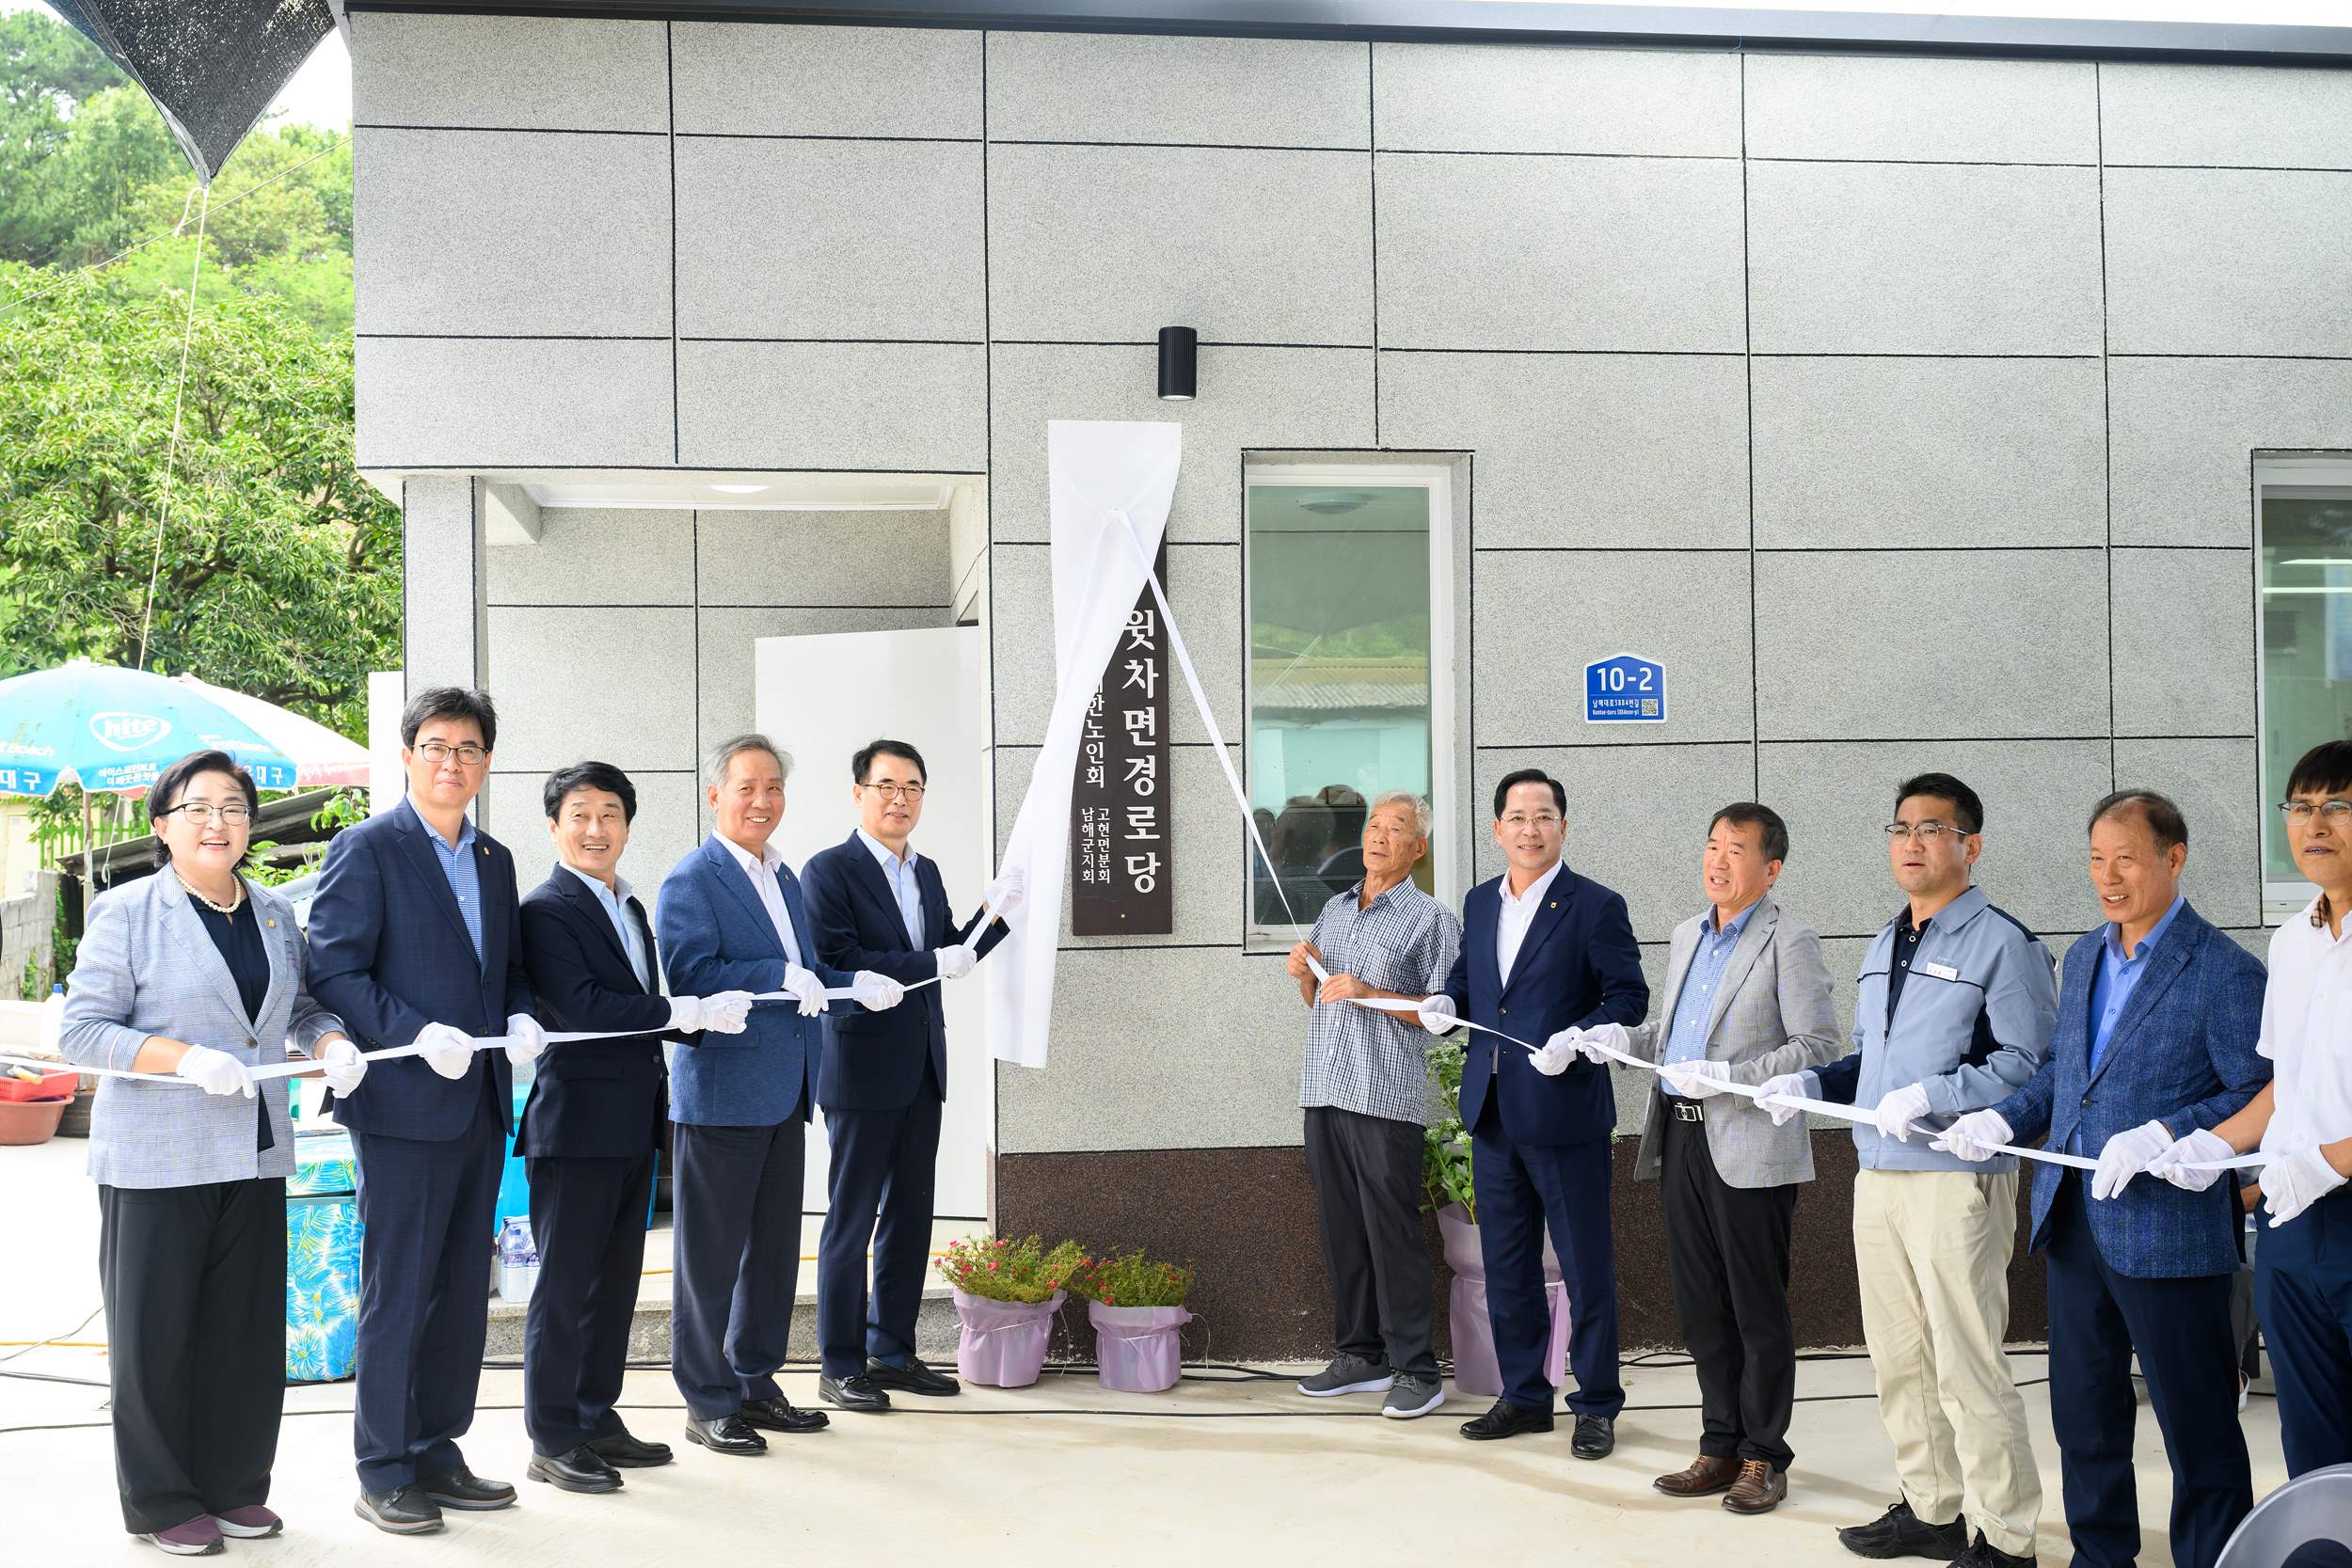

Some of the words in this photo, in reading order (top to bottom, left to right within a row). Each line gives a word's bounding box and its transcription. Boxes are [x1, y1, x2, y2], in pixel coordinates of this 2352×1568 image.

[1597, 667, 1653, 691] 10-2
[104, 718, 158, 738] hite
[1085, 677, 1105, 788] 한노인회
[1121, 610, 1162, 894] 윗차면경로당
[1081, 806, 1095, 884] 남해군지회
[1097, 807, 1111, 884] 고현면분회
